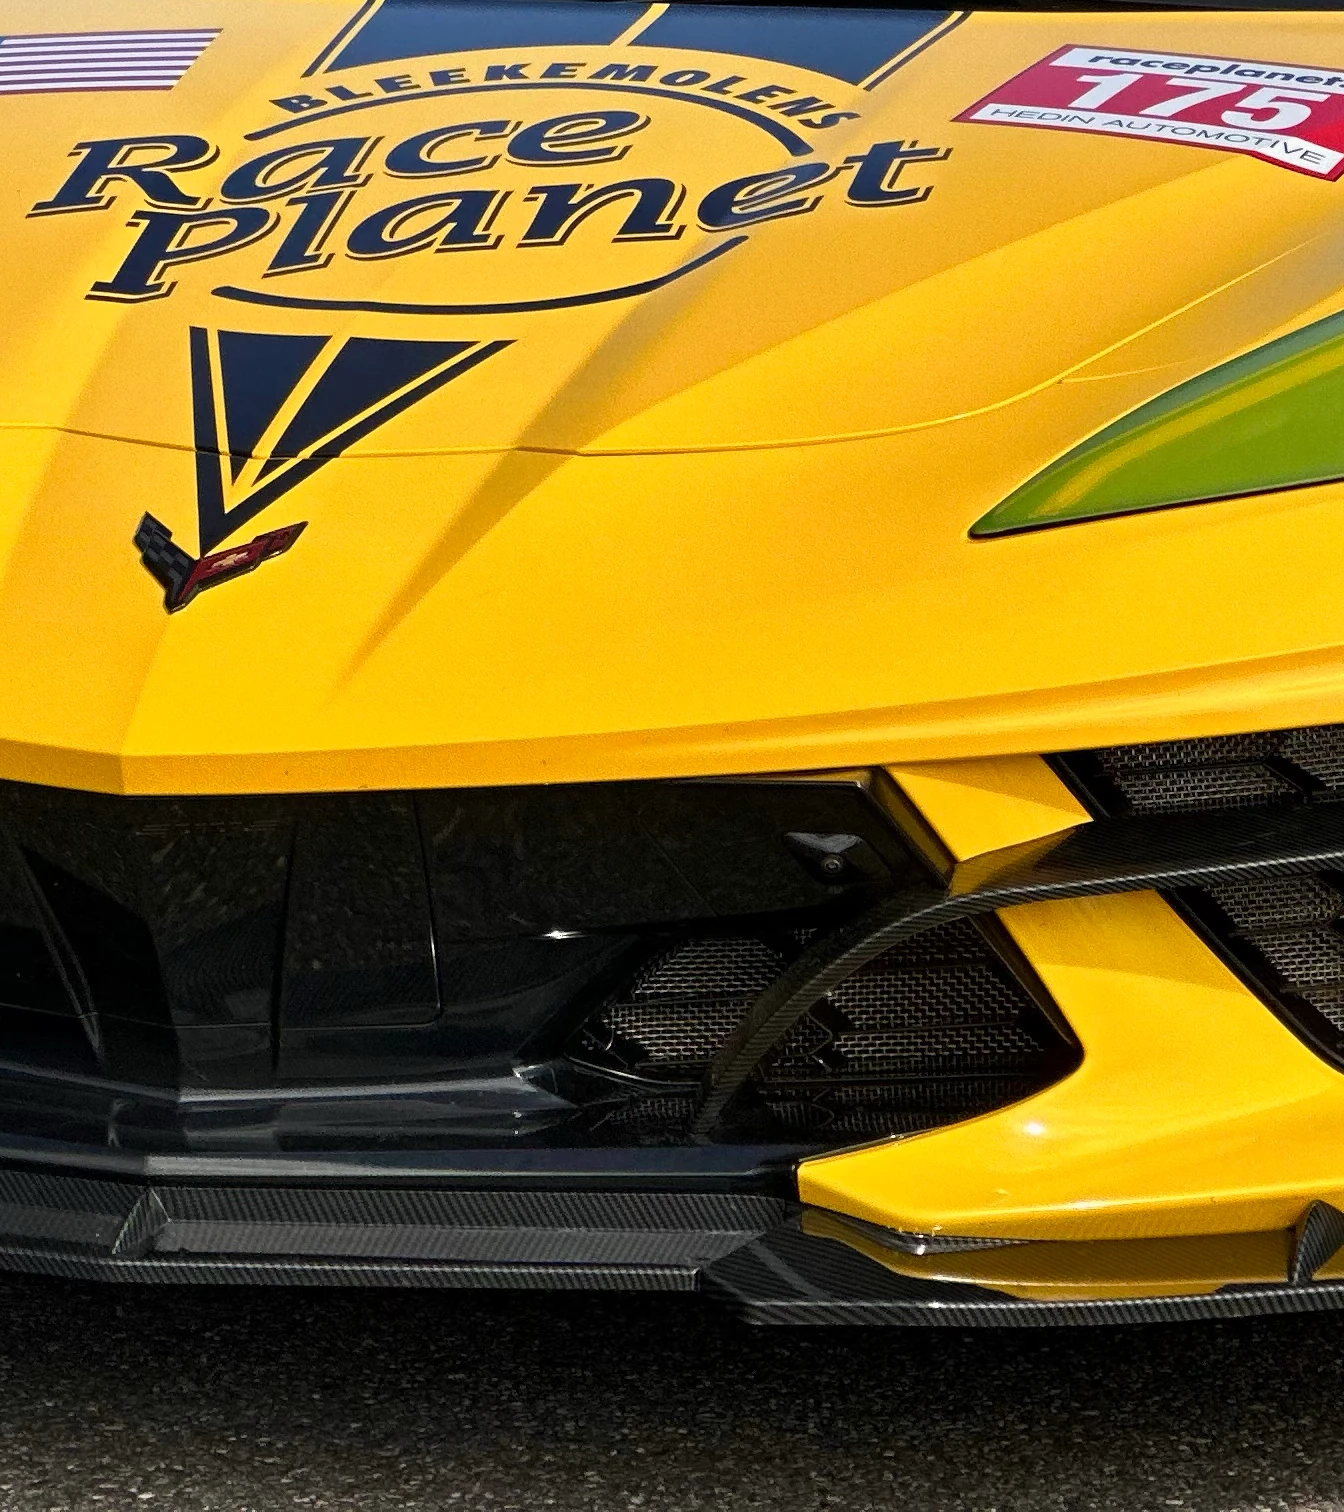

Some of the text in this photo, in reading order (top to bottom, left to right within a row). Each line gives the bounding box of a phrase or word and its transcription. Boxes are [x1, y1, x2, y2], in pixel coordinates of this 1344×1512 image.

[269, 61, 861, 130] BLEEKEMOLENS
[1068, 72, 1333, 132] 175
[26, 109, 653, 220] Race
[990, 107, 1328, 166] HEDIN AUTOMOTIVE
[83, 138, 953, 304] Planet
